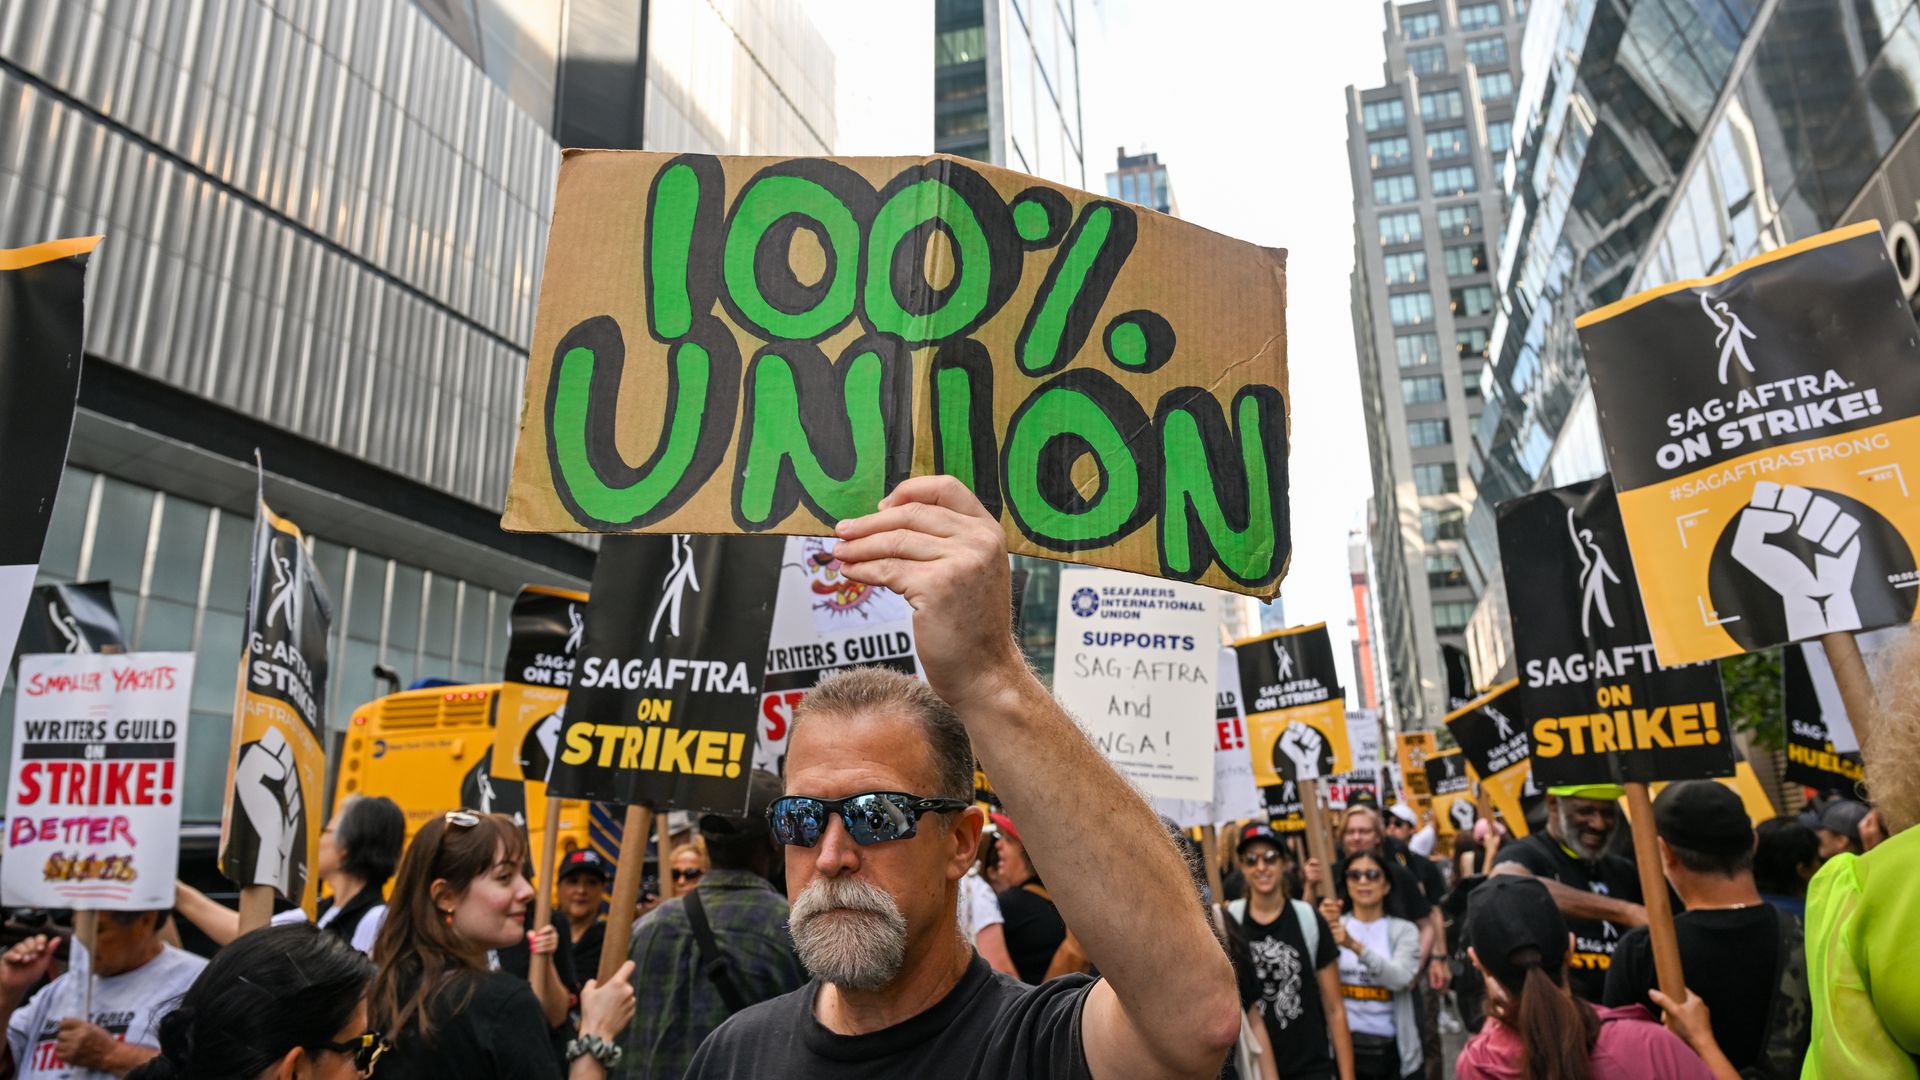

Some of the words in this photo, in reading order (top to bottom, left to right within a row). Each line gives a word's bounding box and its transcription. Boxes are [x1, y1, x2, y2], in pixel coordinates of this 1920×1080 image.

[643, 153, 1176, 376] 100%
[1655, 432, 1712, 470] ON
[1717, 387, 1883, 450] STRIKE!
[544, 313, 1291, 587] UNION
[1669, 432, 1890, 501] #SAGAFTRASTRONG
[1101, 598, 1206, 612] INTERNATIONAL
[1102, 587, 1176, 598] SEAFARERS
[1101, 610, 1141, 620] UNION
[844, 631, 911, 661] GUILD
[1083, 631, 1195, 651] SUPPORTS
[26, 672, 103, 697] SMALLER
[112, 666, 177, 693] YACHTS
[523, 666, 552, 684] ON
[1108, 694, 1151, 719] And
[1255, 697, 1278, 711] ON
[1596, 683, 1633, 708] ON
[637, 698, 672, 723] ON
[24, 720, 107, 742] WRITERS
[115, 720, 177, 742] GUILD
[1532, 701, 1721, 759] STRIKE!
[560, 721, 746, 779] STRIKE!
[17, 761, 177, 806] STRIKE!
[10, 815, 137, 848] BETTER
